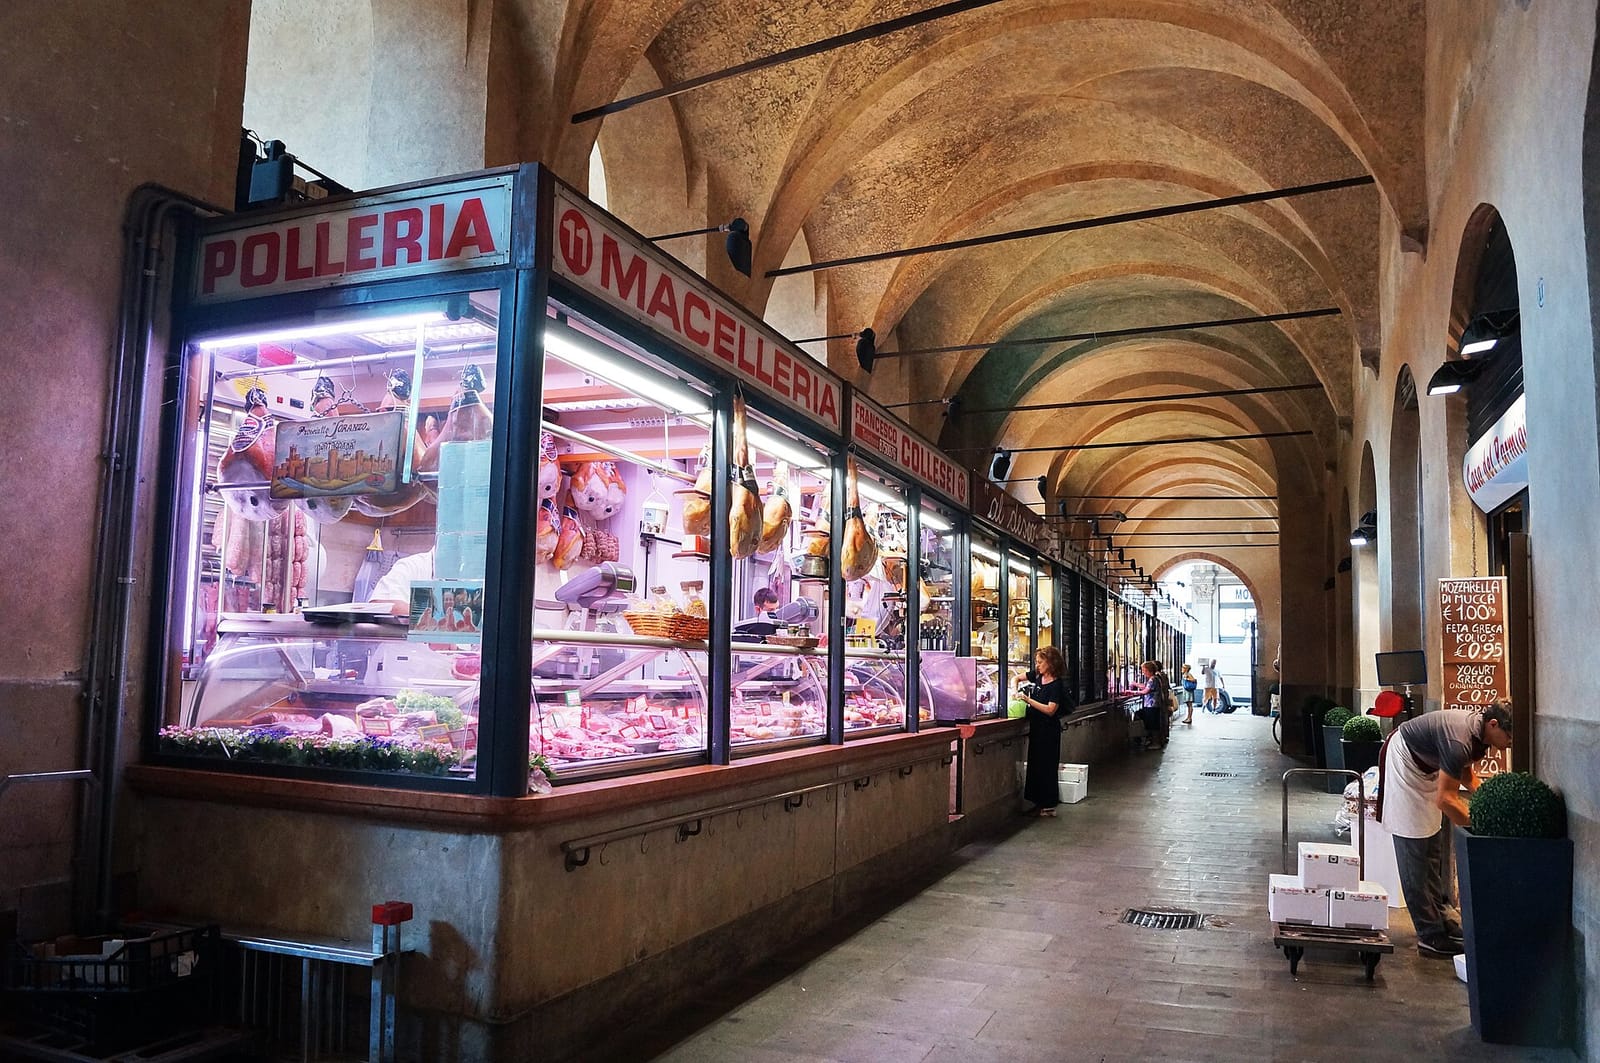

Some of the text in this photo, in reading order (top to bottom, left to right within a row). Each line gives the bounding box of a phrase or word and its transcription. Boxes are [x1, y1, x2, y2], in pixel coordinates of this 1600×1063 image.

[203, 197, 496, 295] POLLERIA
[563, 218, 838, 425] 11 MACELLERIA
[855, 402, 898, 444] FRANCESCO
[901, 434, 956, 497] COLLESEI
[1466, 463, 1486, 494] Casa
[1482, 446, 1498, 481] del
[1441, 580, 1500, 594] MOZZARELLA
[1235, 589, 1253, 600] MO
[1441, 594, 1496, 605] DI MUCCA
[1442, 604, 1452, 621] €
[1446, 623, 1503, 634] FETA GRECA
[1456, 633, 1496, 644] KOLIOS
[1456, 664, 1497, 676] YOGURT
[1457, 674, 1494, 686] GRECO
